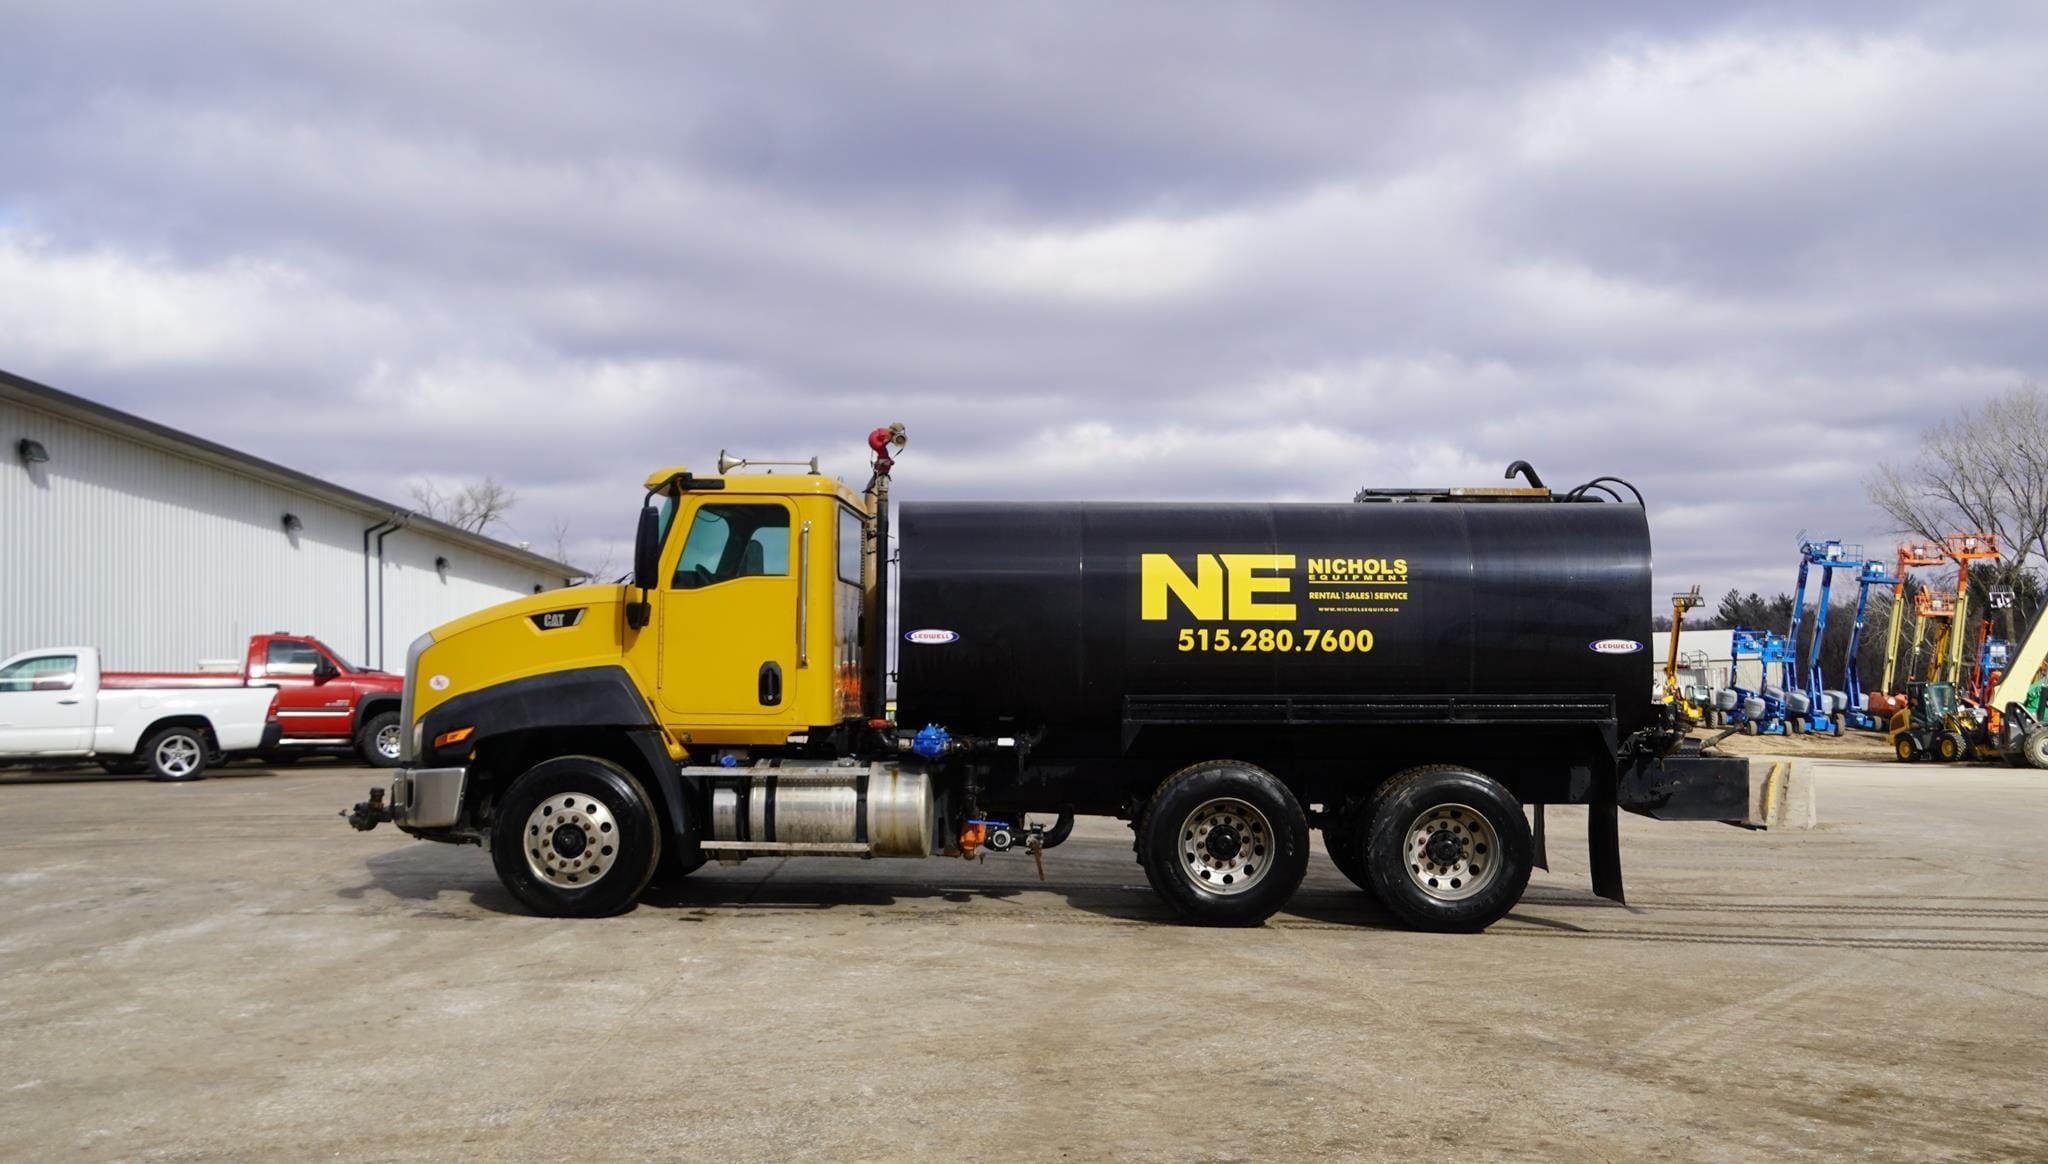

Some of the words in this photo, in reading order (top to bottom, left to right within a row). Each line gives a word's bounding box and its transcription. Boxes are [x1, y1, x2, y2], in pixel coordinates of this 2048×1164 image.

[1308, 558, 1408, 574] NICHOLS
[1141, 553, 1297, 621] NE
[1309, 592, 1341, 600] RENTAL
[1345, 592, 1370, 600] SALES
[1374, 592, 1408, 600] SERVICE
[543, 613, 565, 627] CAT
[1178, 628, 1374, 652] 515.280.7600
